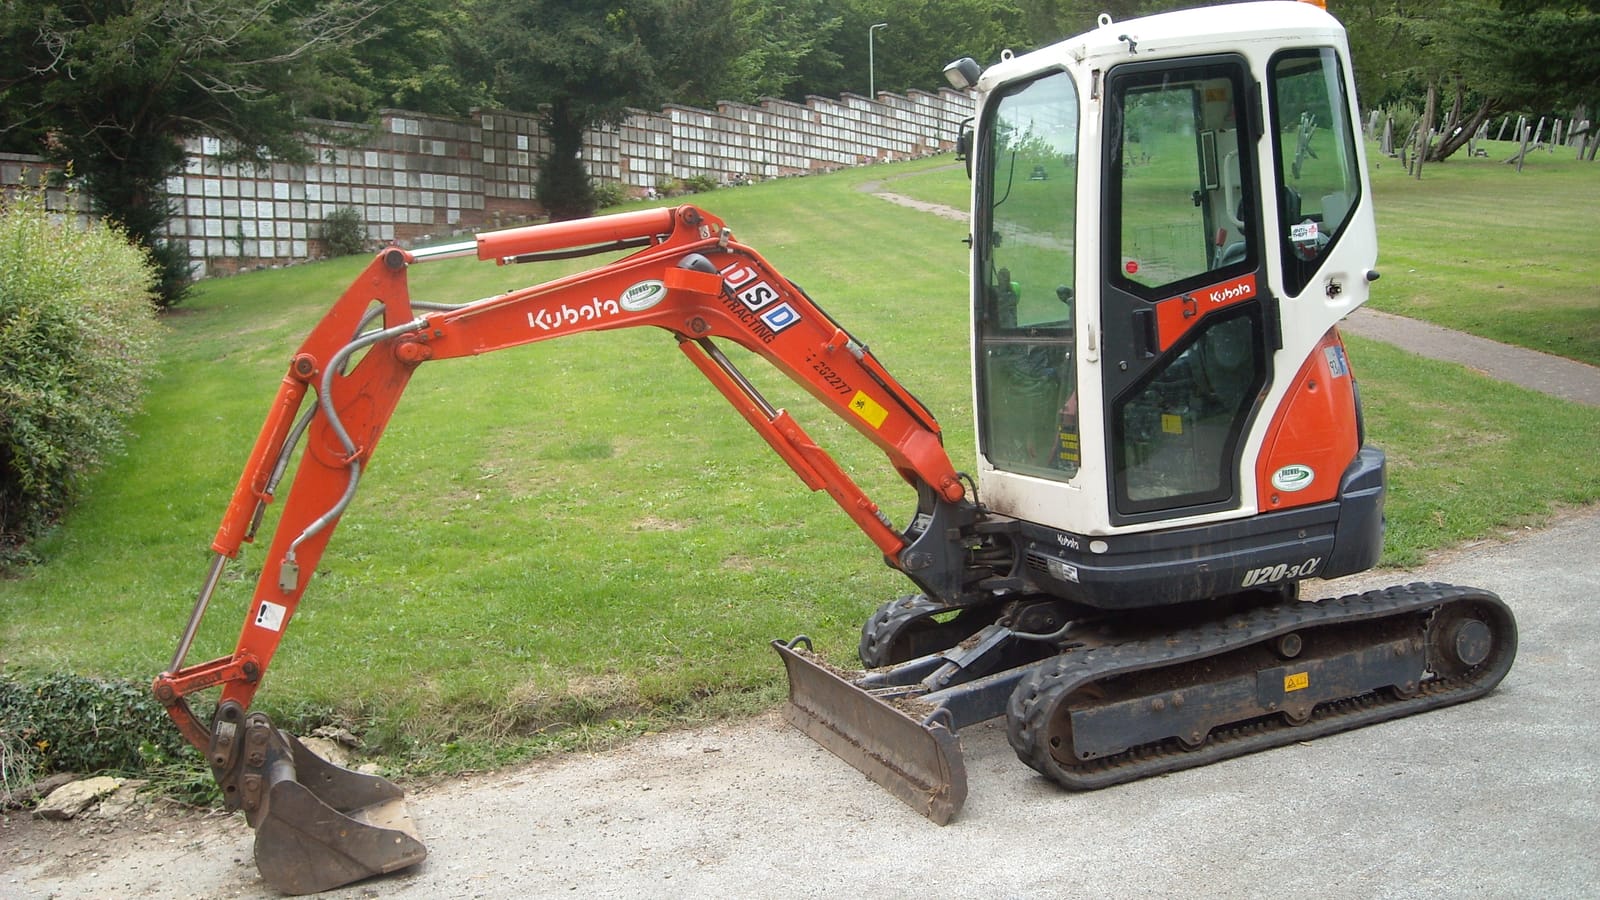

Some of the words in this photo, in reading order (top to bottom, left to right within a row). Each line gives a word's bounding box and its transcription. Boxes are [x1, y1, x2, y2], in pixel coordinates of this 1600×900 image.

[527, 297, 619, 330] Kubota
[720, 261, 796, 328] DSD
[1210, 284, 1251, 302] Kubota
[718, 291, 775, 344] NTRACTING
